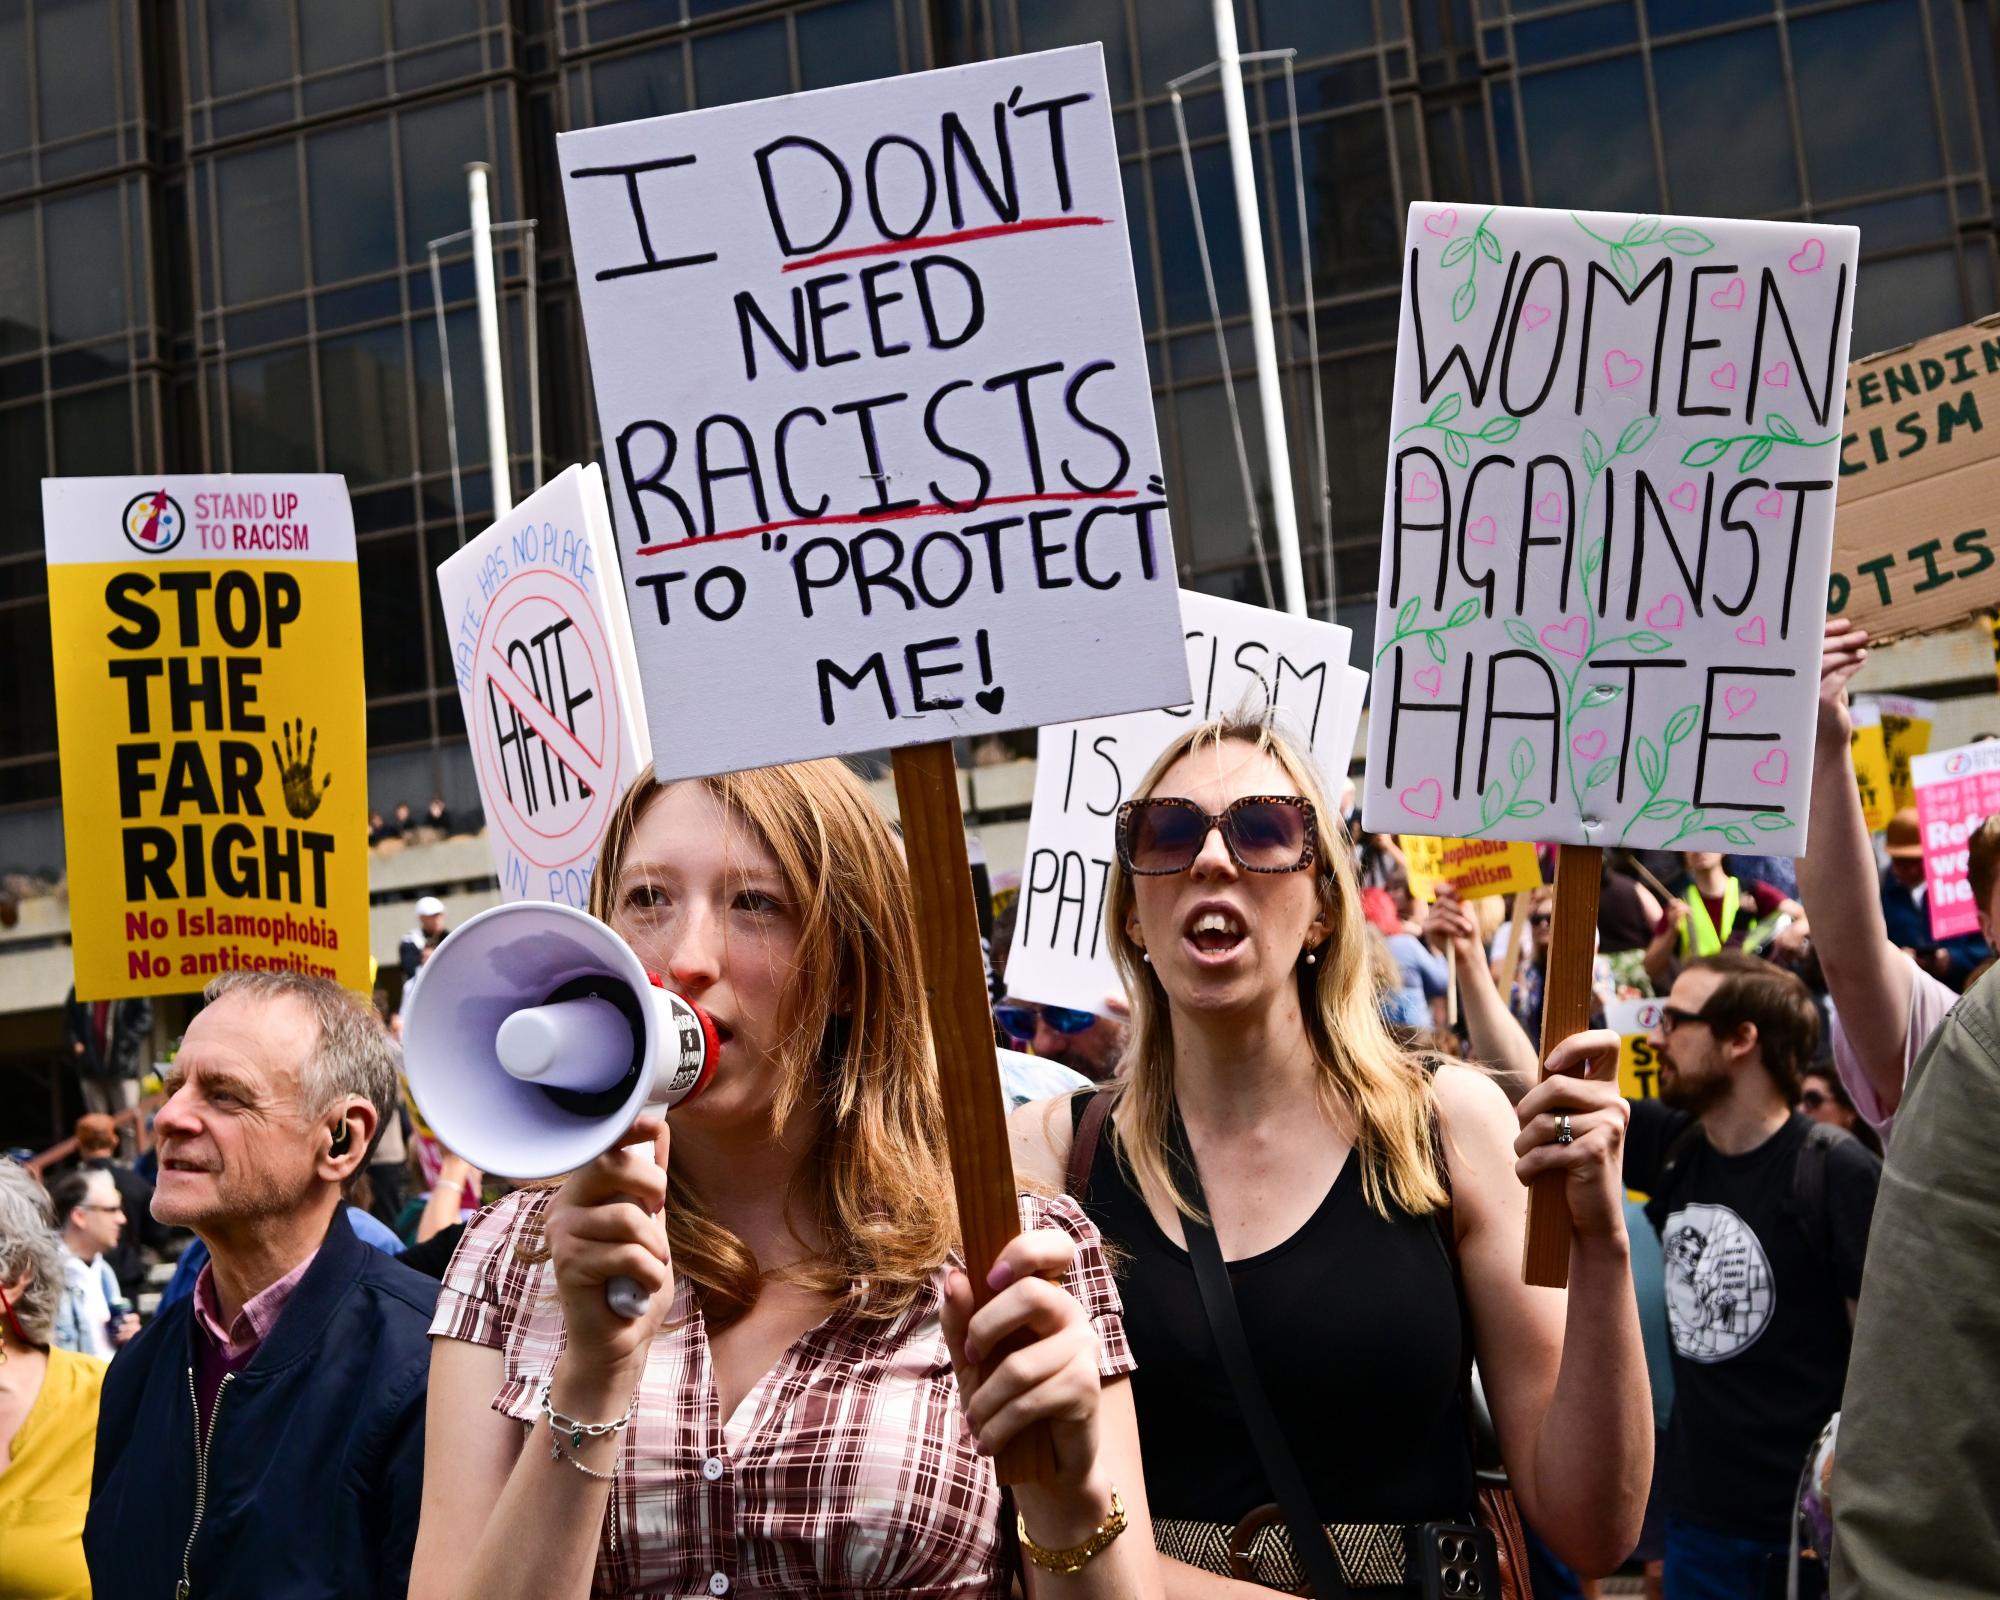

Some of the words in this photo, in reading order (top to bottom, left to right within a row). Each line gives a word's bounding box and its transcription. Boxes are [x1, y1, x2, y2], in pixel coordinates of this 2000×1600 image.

[571, 155, 717, 282] I
[755, 86, 1095, 256] DON'T
[734, 256, 984, 381] NEED
[1411, 248, 1847, 426] WOMEN
[1844, 336, 2000, 416] ENDIN
[616, 361, 1131, 543] RACISTS
[194, 493, 267, 520] STAND
[272, 493, 298, 520] UP
[195, 523, 226, 550] TO
[232, 523, 309, 550] RACISM
[1390, 446, 1834, 640] AGAINST
[105, 570, 301, 650] STOP
[457, 597, 482, 693] HATE
[476, 546, 509, 600] HAS
[512, 525, 539, 568] NO
[543, 522, 594, 593] PLACE
[636, 571, 747, 625] TO
[109, 656, 266, 734] THE
[487, 617, 594, 817] HATE
[817, 629, 1005, 725] ME!
[1384, 645, 1796, 813] HATE
[116, 741, 265, 819] FAR
[1063, 730, 1122, 817] IS
[122, 824, 335, 908] RIGHT
[505, 849, 529, 897] IN
[125, 911, 168, 941] No
[177, 907, 338, 950] Islamophobia
[128, 950, 171, 980] No
